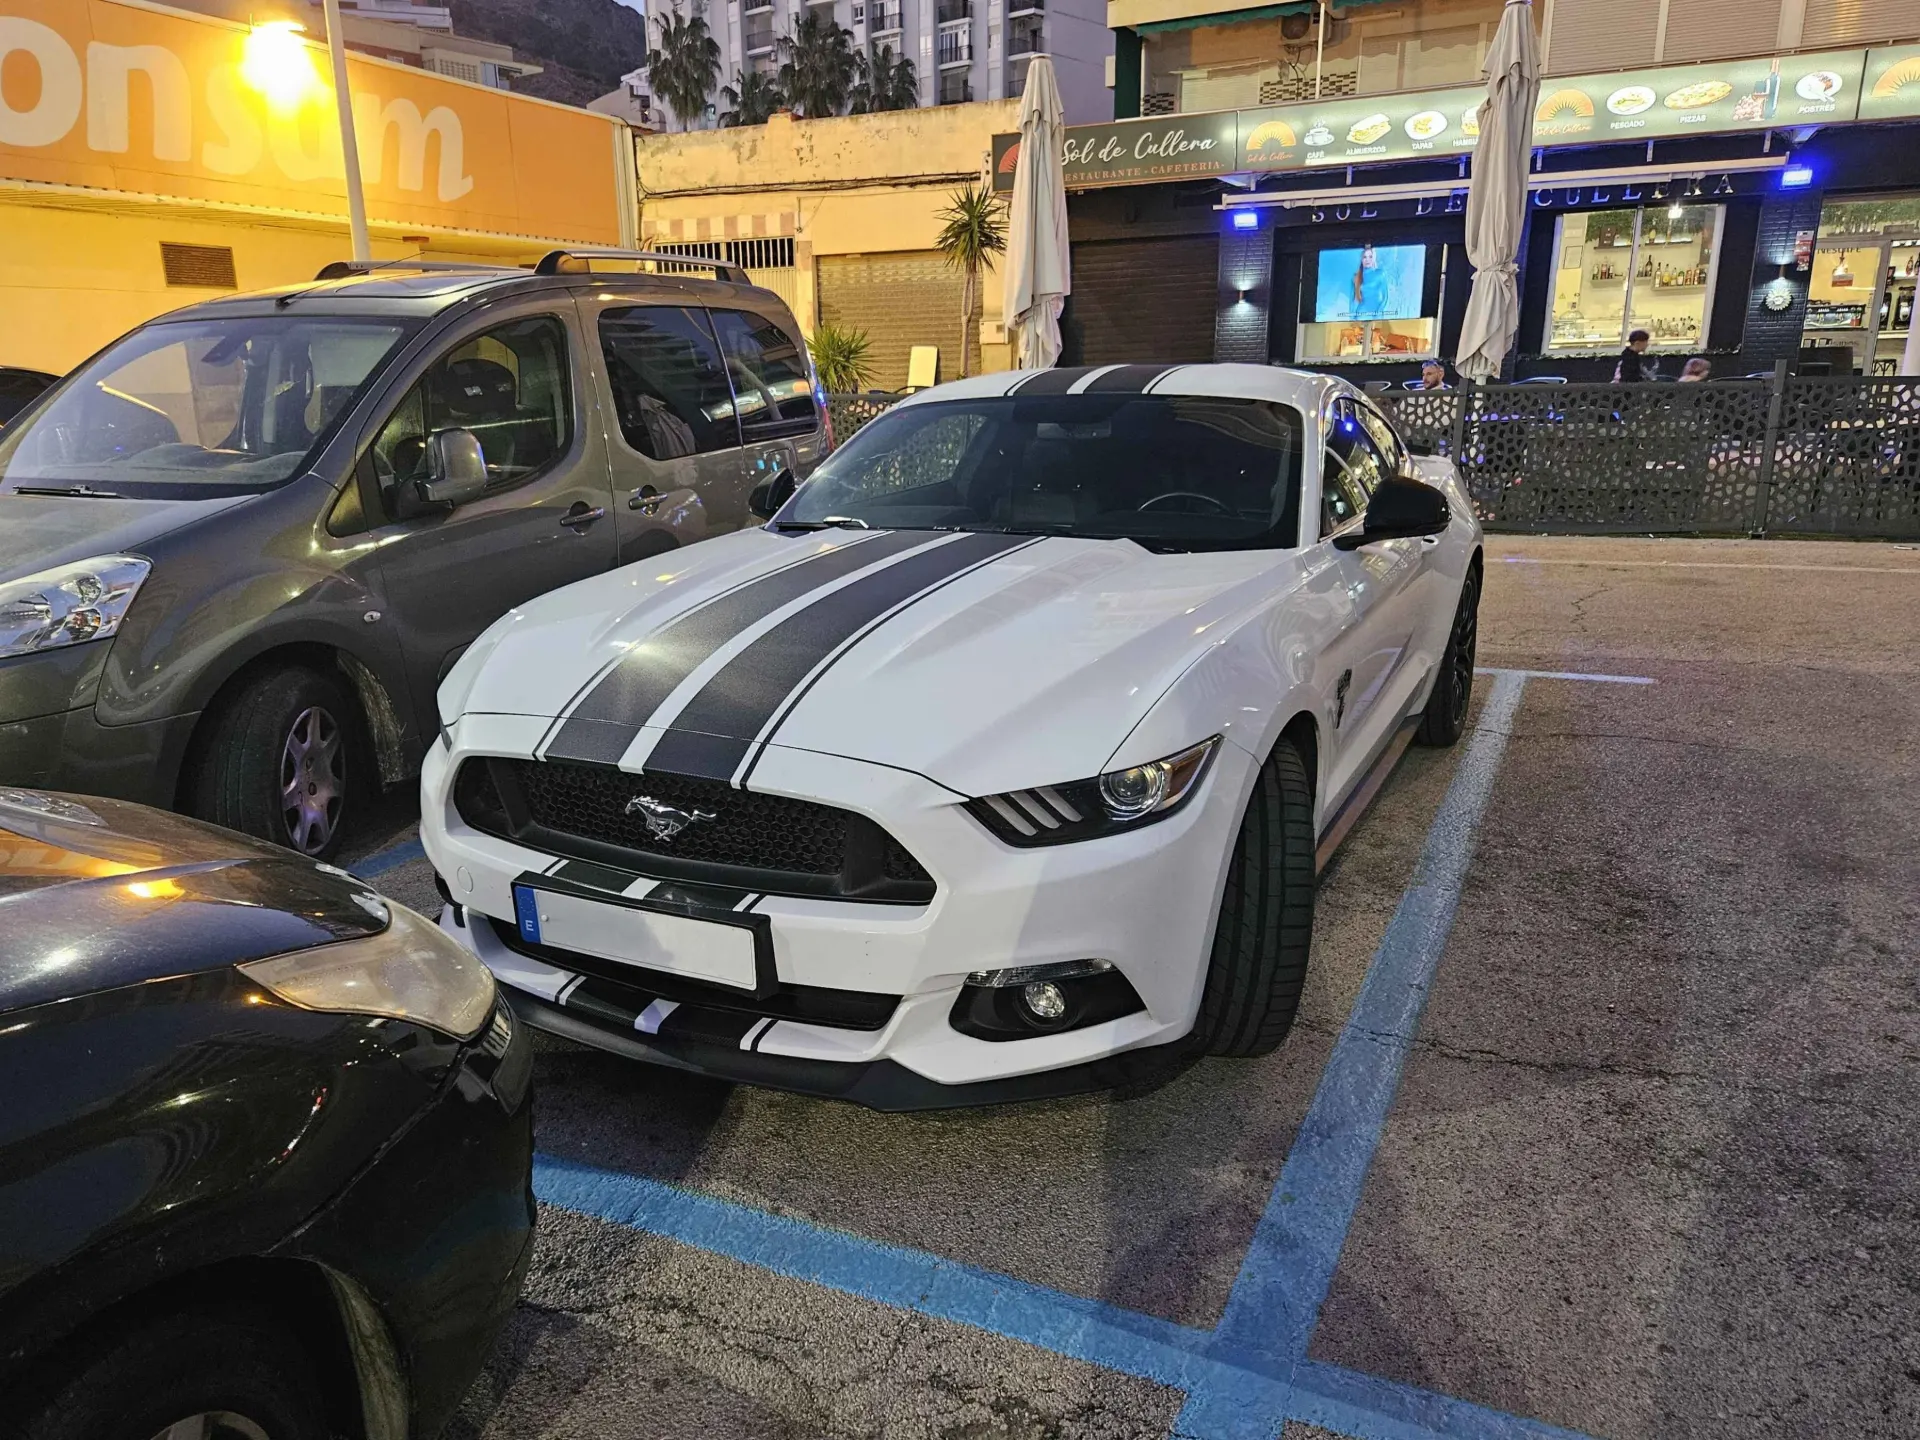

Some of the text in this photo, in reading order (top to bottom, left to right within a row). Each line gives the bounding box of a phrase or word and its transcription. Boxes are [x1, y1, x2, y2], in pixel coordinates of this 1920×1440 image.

[1798, 104, 1835, 114] POSTRES
[1680, 115, 1706, 123] PIZZAS
[1610, 120, 1645, 129] PESCADO
[1412, 142, 1433, 150] TAPAS
[1452, 137, 1478, 147] HAMBU
[1061, 129, 1218, 166] Sol de Cullera
[1345, 145, 1386, 155] ALMUERZOS
[1064, 167, 1141, 181] ESTAURANTE
[1415, 193, 1463, 215] DE
[1534, 174, 1734, 207] CULLERA
[525, 920, 534, 931] E
